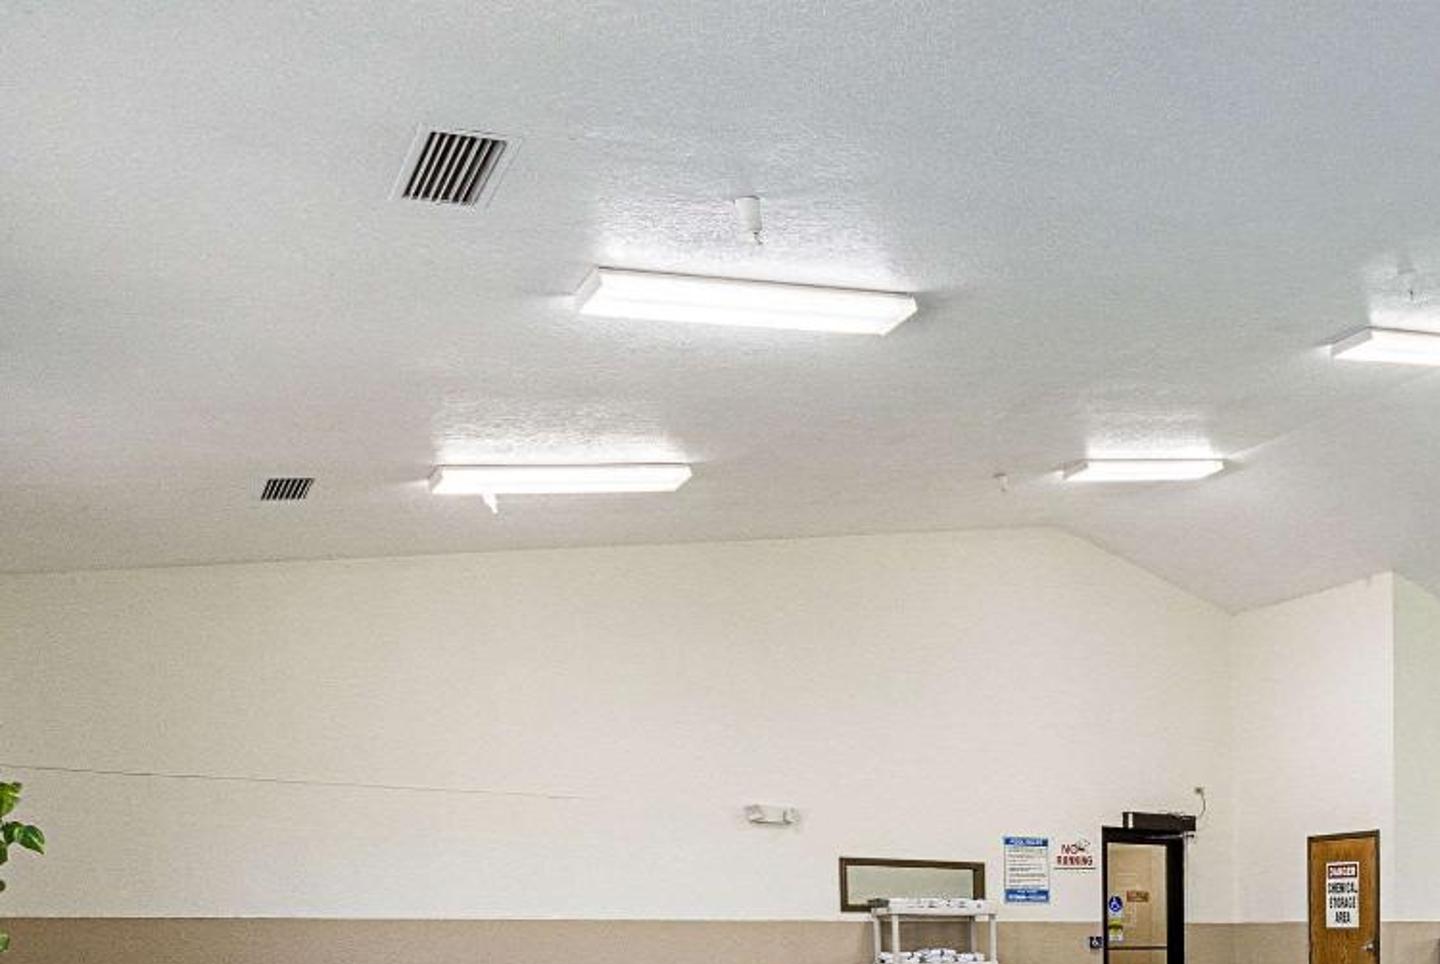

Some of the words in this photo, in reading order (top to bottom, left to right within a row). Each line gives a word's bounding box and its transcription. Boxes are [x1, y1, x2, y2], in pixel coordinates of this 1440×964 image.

[1061, 844, 1078, 854] NO
[1056, 856, 1093, 866] RUNNING
[1328, 882, 1358, 893] CHEMICAL
[1329, 896, 1356, 909] STORAGE
[1335, 911, 1351, 923] AREA
